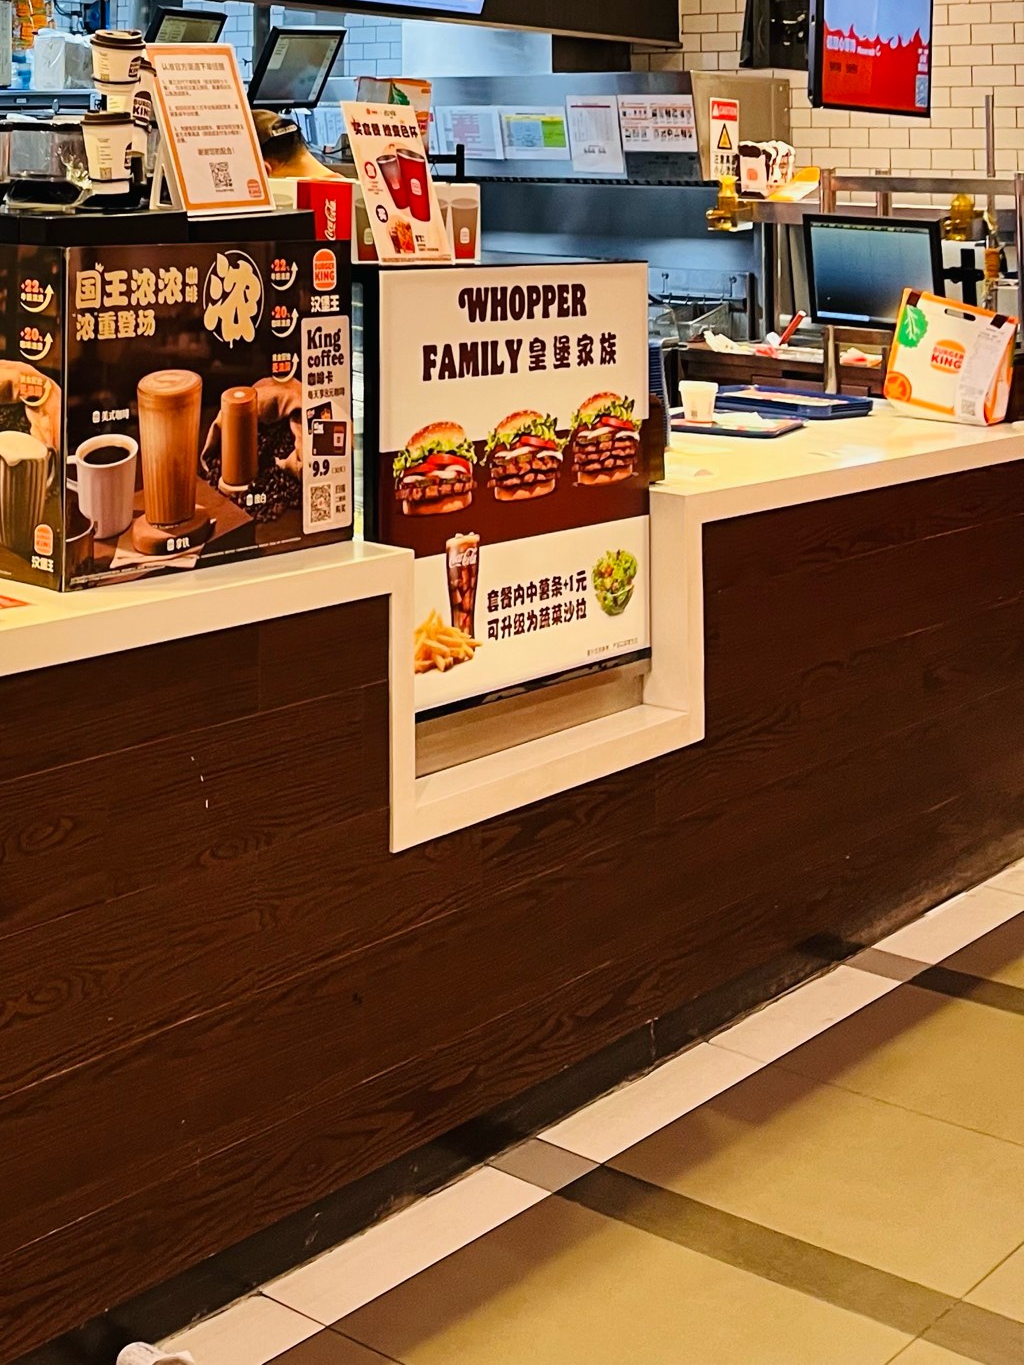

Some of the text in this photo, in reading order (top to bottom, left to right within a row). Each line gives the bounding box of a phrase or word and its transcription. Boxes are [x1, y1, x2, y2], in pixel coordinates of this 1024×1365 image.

[133, 106, 151, 118] KIN
[314, 262, 335, 271] BURGER
[314, 270, 335, 282] KING
[310, 295, 339, 313] 汉堡王
[458, 283, 587, 323] WHOPPER
[307, 326, 341, 351] King
[307, 349, 344, 368] coffee
[422, 332, 617, 381] FAMILY 皇堡家族
[930, 354, 962, 369] KING
[933, 347, 964, 359] BURGER
[307, 371, 334, 386] 咖啡卡
[31, 556, 54, 574] 汉堡王
[486, 570, 587, 613] 套餐内中薯条+1元
[486, 597, 587, 641] 可升级为蔬菜沙拉
